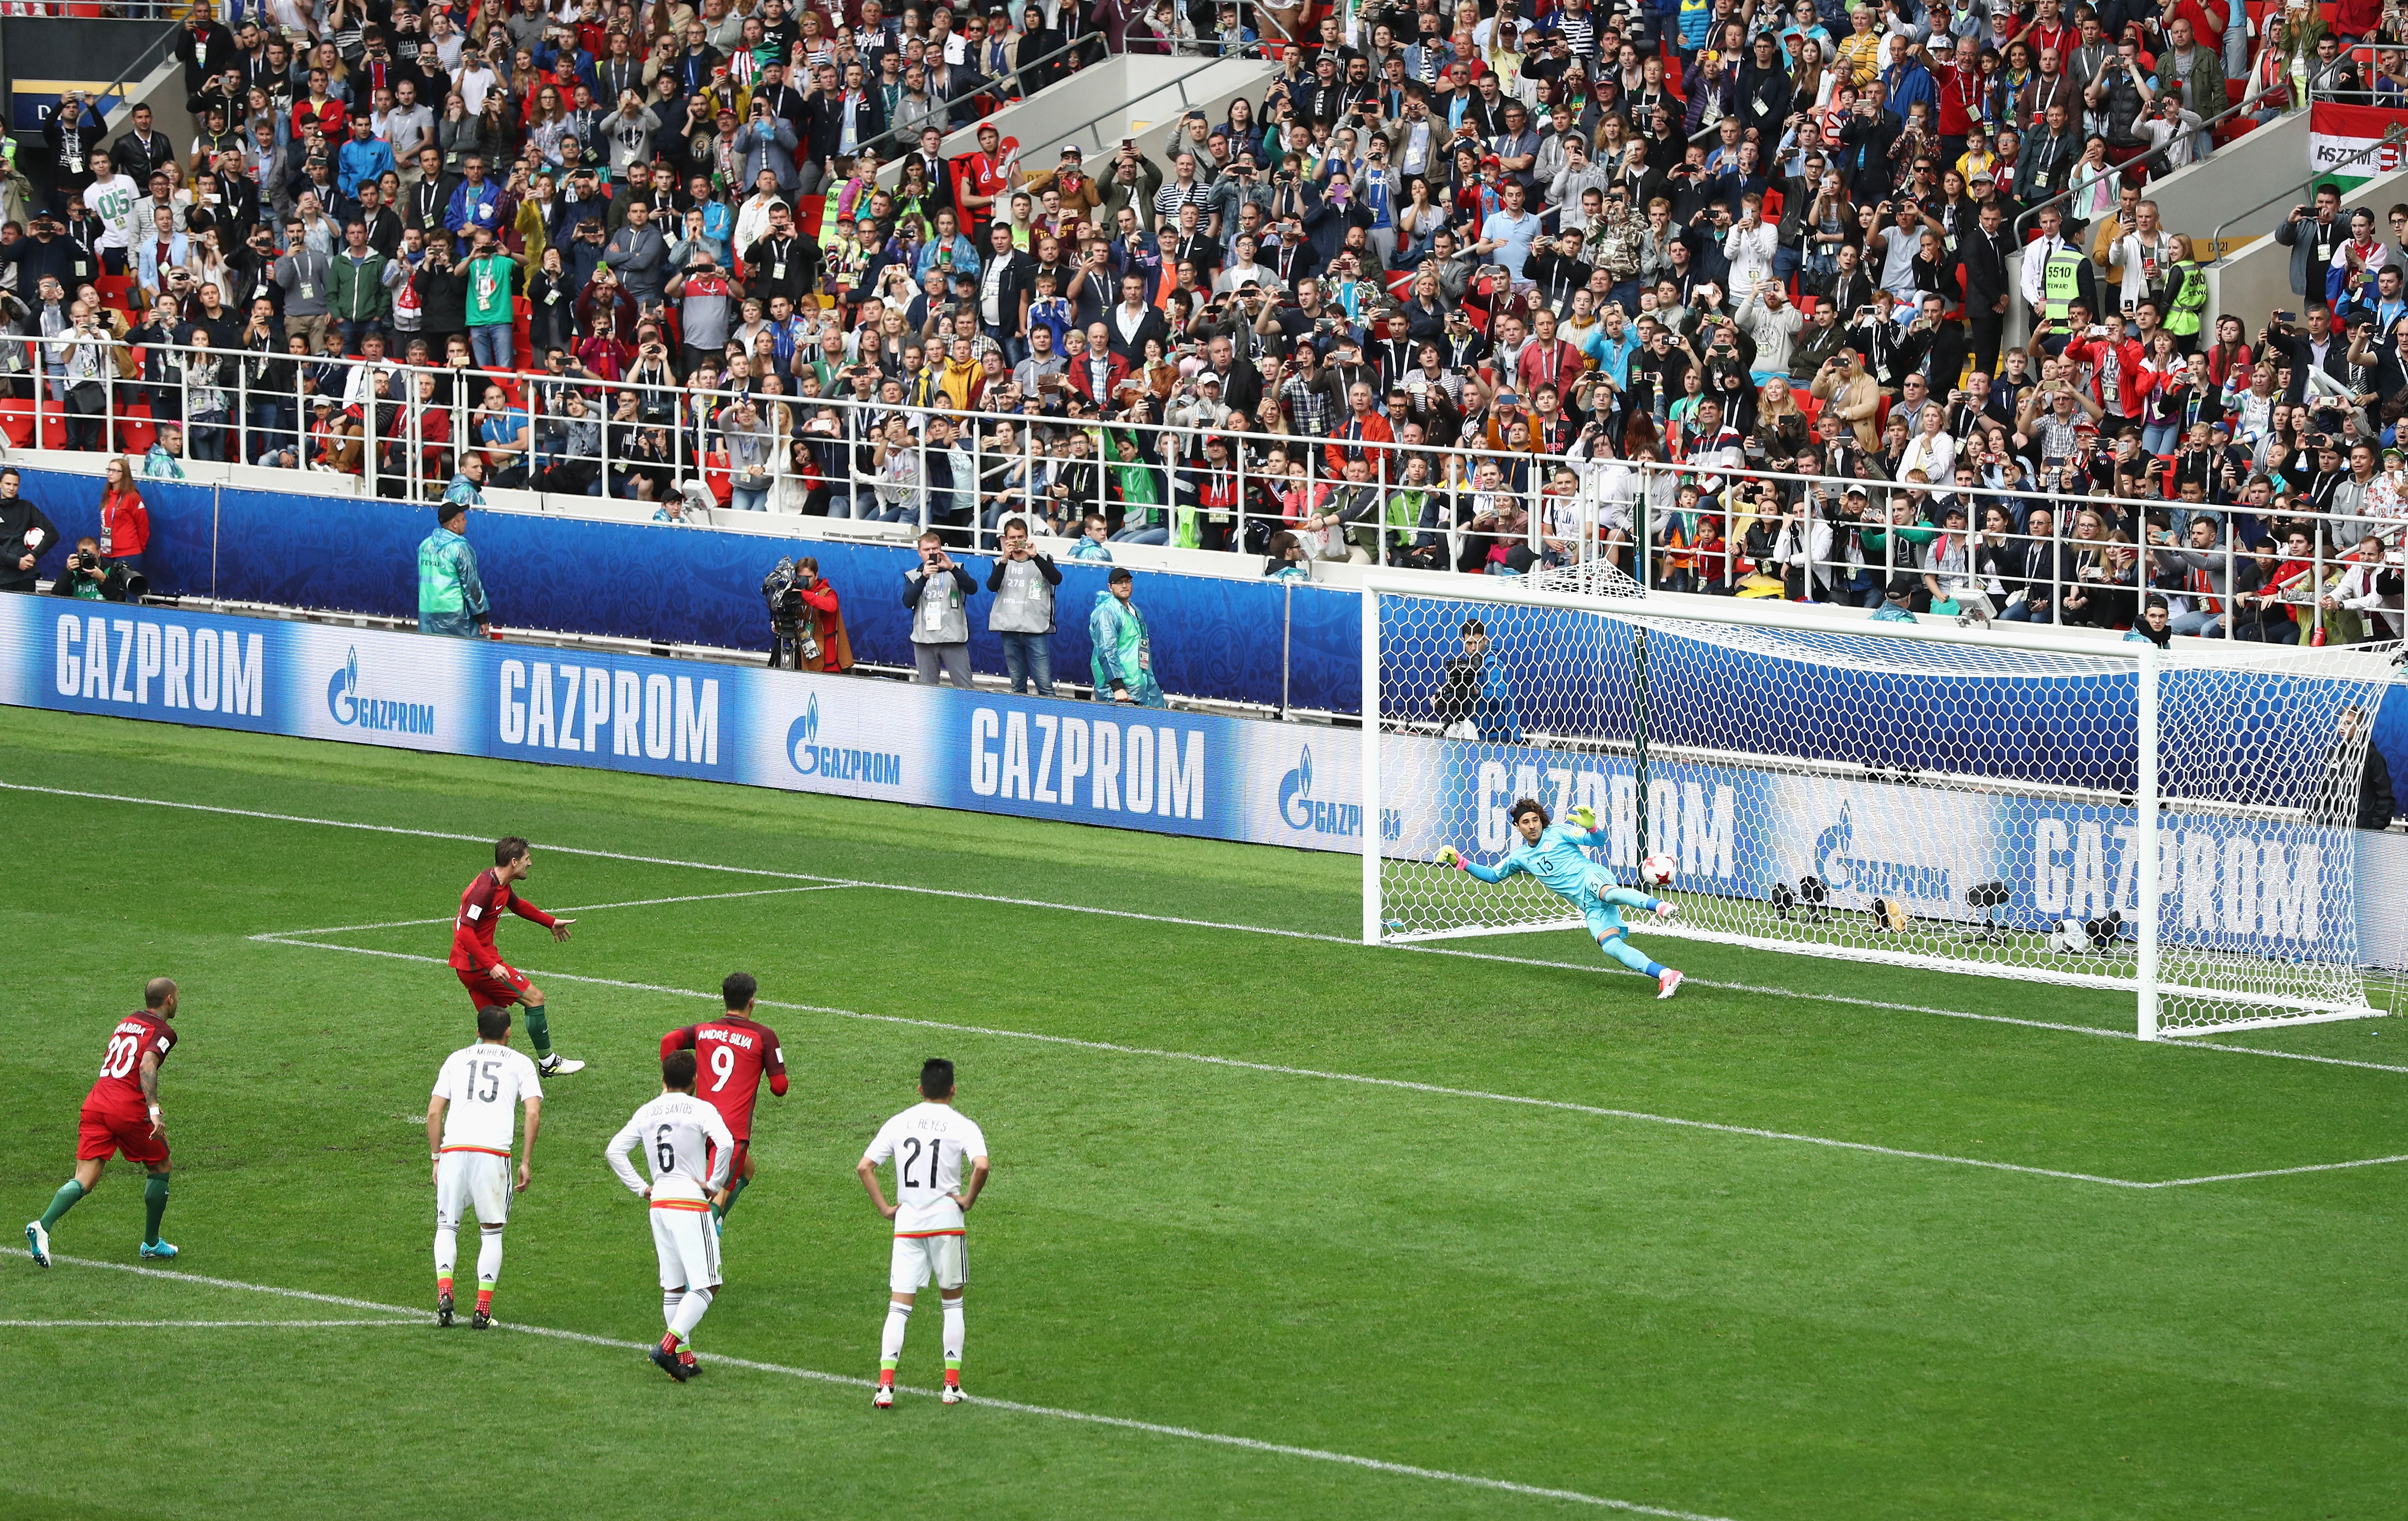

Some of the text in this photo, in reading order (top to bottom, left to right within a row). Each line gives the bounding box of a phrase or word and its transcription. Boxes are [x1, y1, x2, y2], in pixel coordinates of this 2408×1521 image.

[99, 189, 130, 220] 05
[2208, 241, 2229, 253] D21
[2048, 266, 2071, 278] 5510
[1007, 579, 1025, 587] 278
[1011, 566, 1024, 575] HB
[56, 614, 264, 717] GAZPROM
[359, 698, 434, 735] GAZPROM
[499, 659, 719, 765] GAZPROM
[820, 746, 900, 785] GAZPROM
[970, 708, 1204, 820] GAZPROM
[1315, 801, 1401, 841] GAZPM
[1536, 856, 1553, 875] 13
[99, 1035, 138, 1078] 20
[476, 1048, 512, 1059] MORENO
[698, 1029, 753, 1050] ANDRÉ SILVA
[466, 1059, 502, 1103] 15
[711, 1045, 735, 1092] 9
[651, 1105, 663, 1116] DOS
[665, 1102, 694, 1115] SANTOS
[918, 1118, 949, 1133] REYES
[657, 1124, 674, 1173] 6
[903, 1137, 941, 1189] 21
